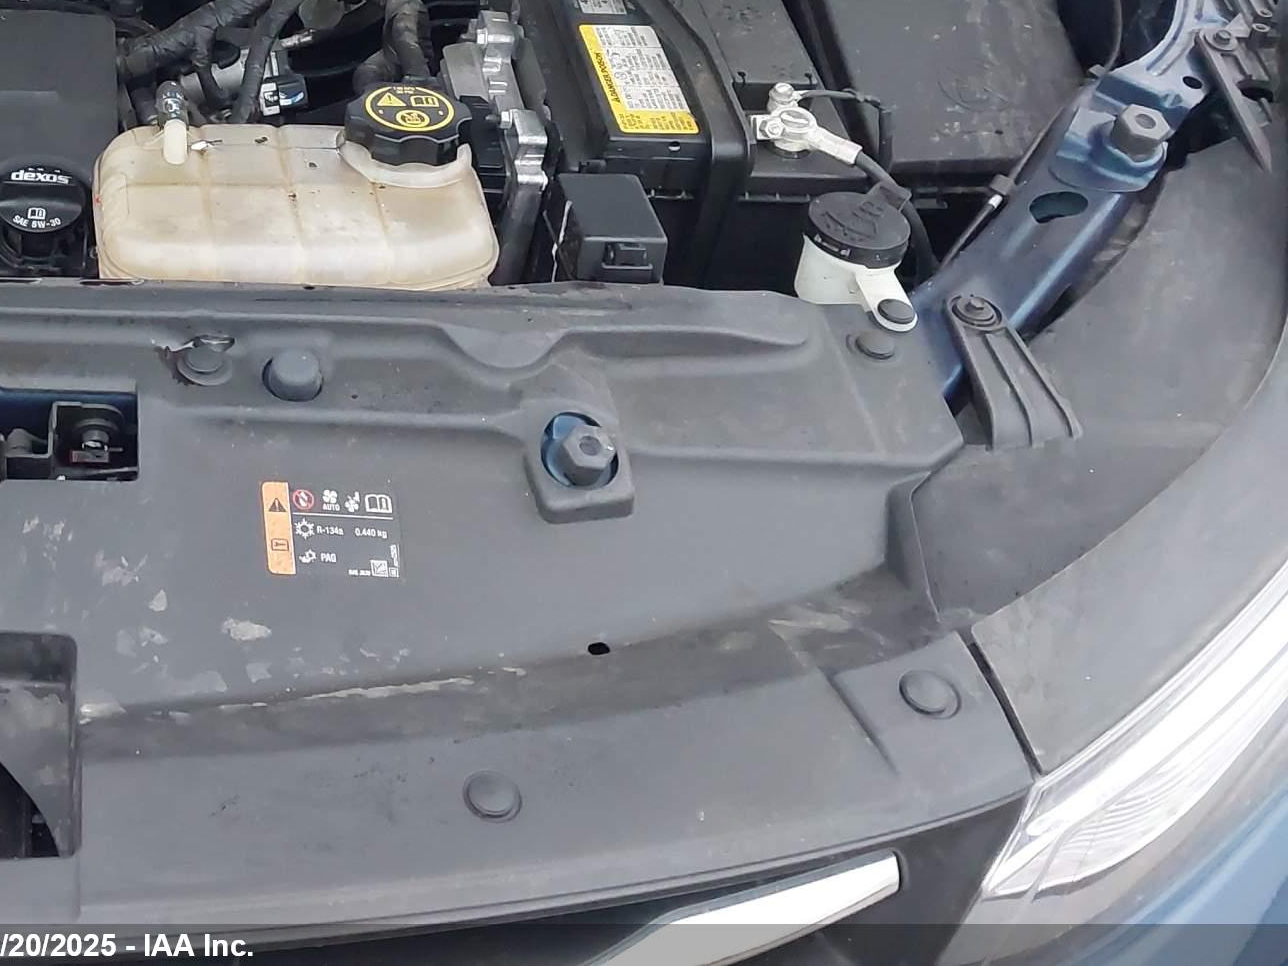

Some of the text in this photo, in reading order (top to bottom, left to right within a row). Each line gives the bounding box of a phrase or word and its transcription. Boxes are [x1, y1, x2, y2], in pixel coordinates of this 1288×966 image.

[11, 170, 72, 184] dexos
[13, 215, 61, 229] SAE 5W-30
[323, 503, 341, 511] AUTO
[316, 525, 344, 536] R-134a
[377, 529, 387, 539] kg
